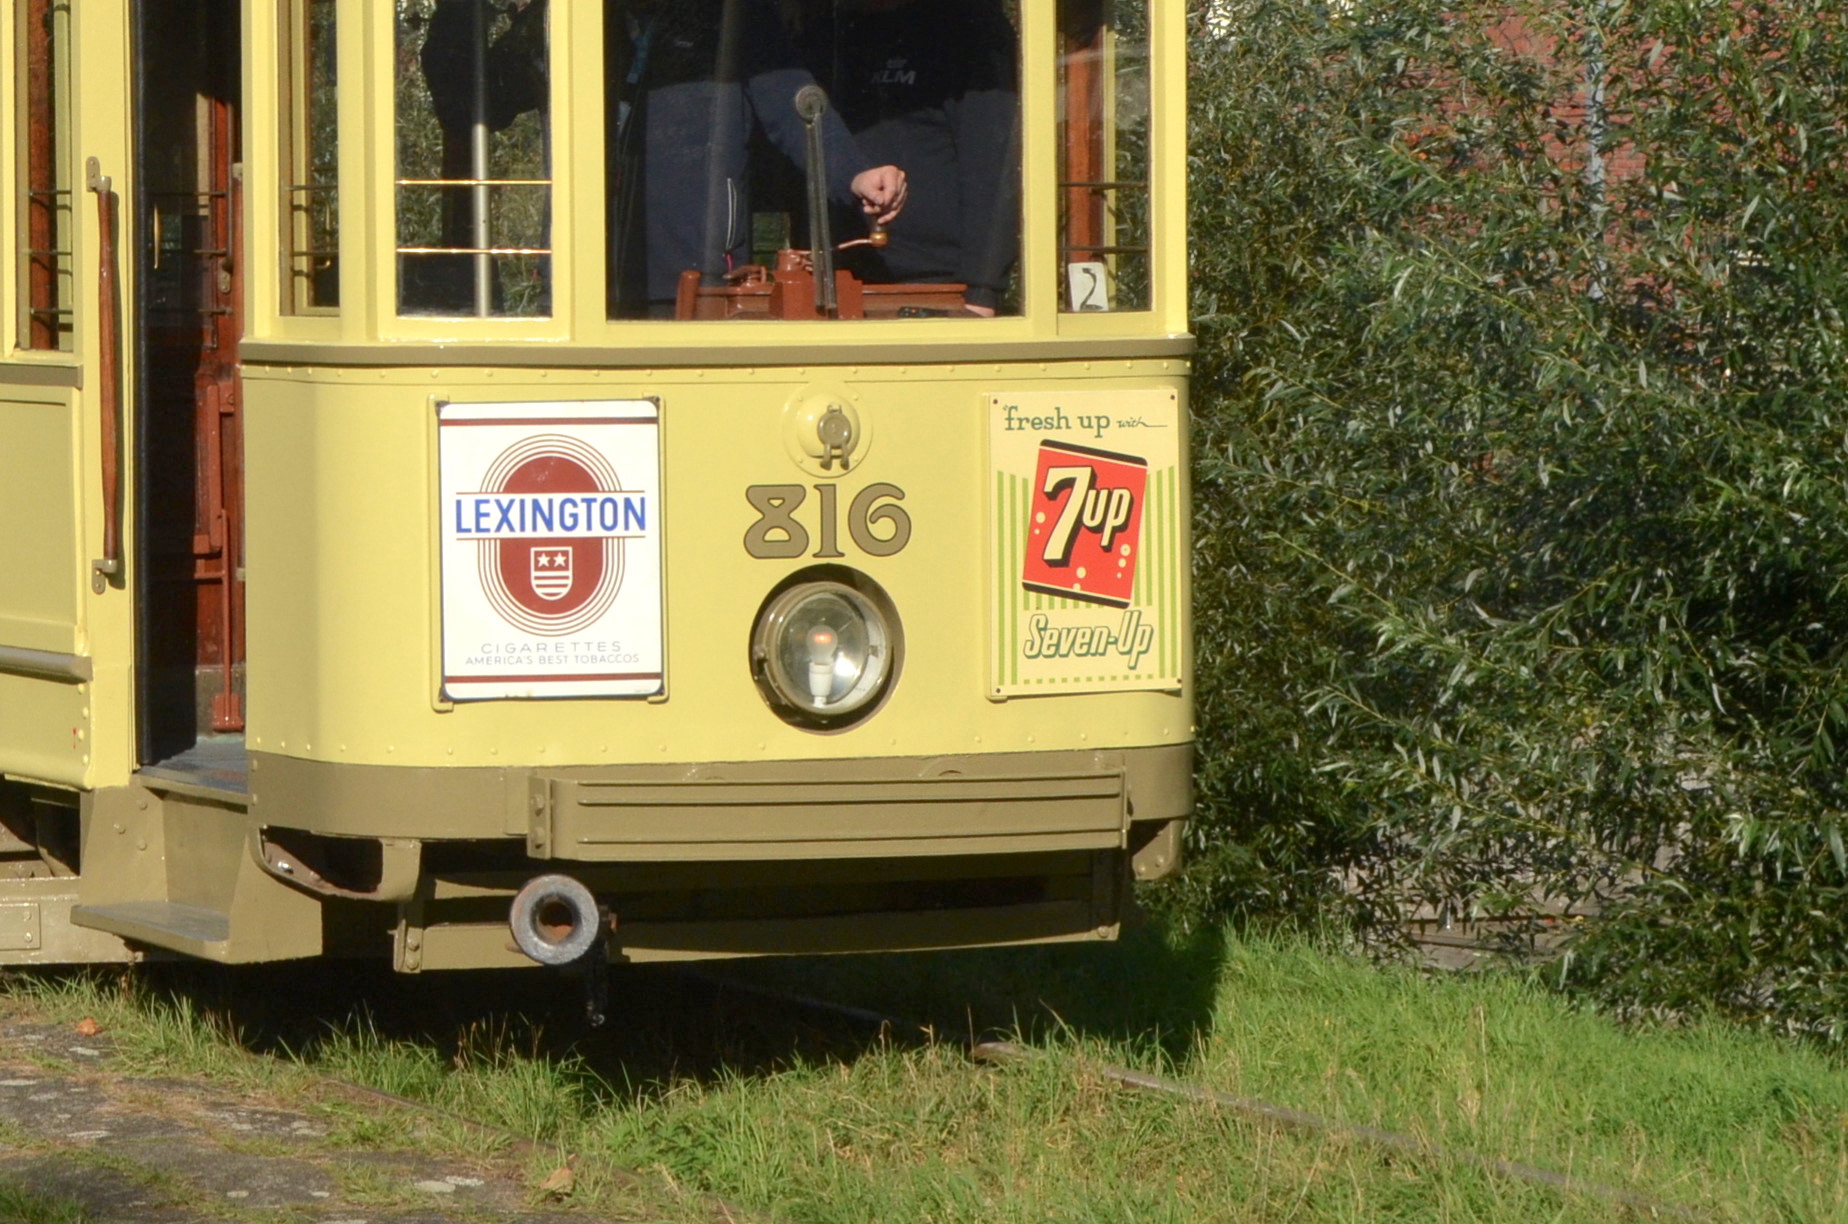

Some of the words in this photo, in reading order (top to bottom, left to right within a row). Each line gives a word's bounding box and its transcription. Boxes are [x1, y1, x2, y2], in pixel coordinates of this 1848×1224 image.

[1079, 267, 1104, 311] 2
[455, 496, 647, 533] LEXINGTON
[743, 482, 912, 559] 816
[465, 656, 534, 666] AMERICA'S
[538, 654, 569, 665] BEST
[574, 653, 640, 665] TOBACCOS
[480, 641, 622, 655] CIGARETTES
[1023, 610, 1154, 670] Seven-Up
